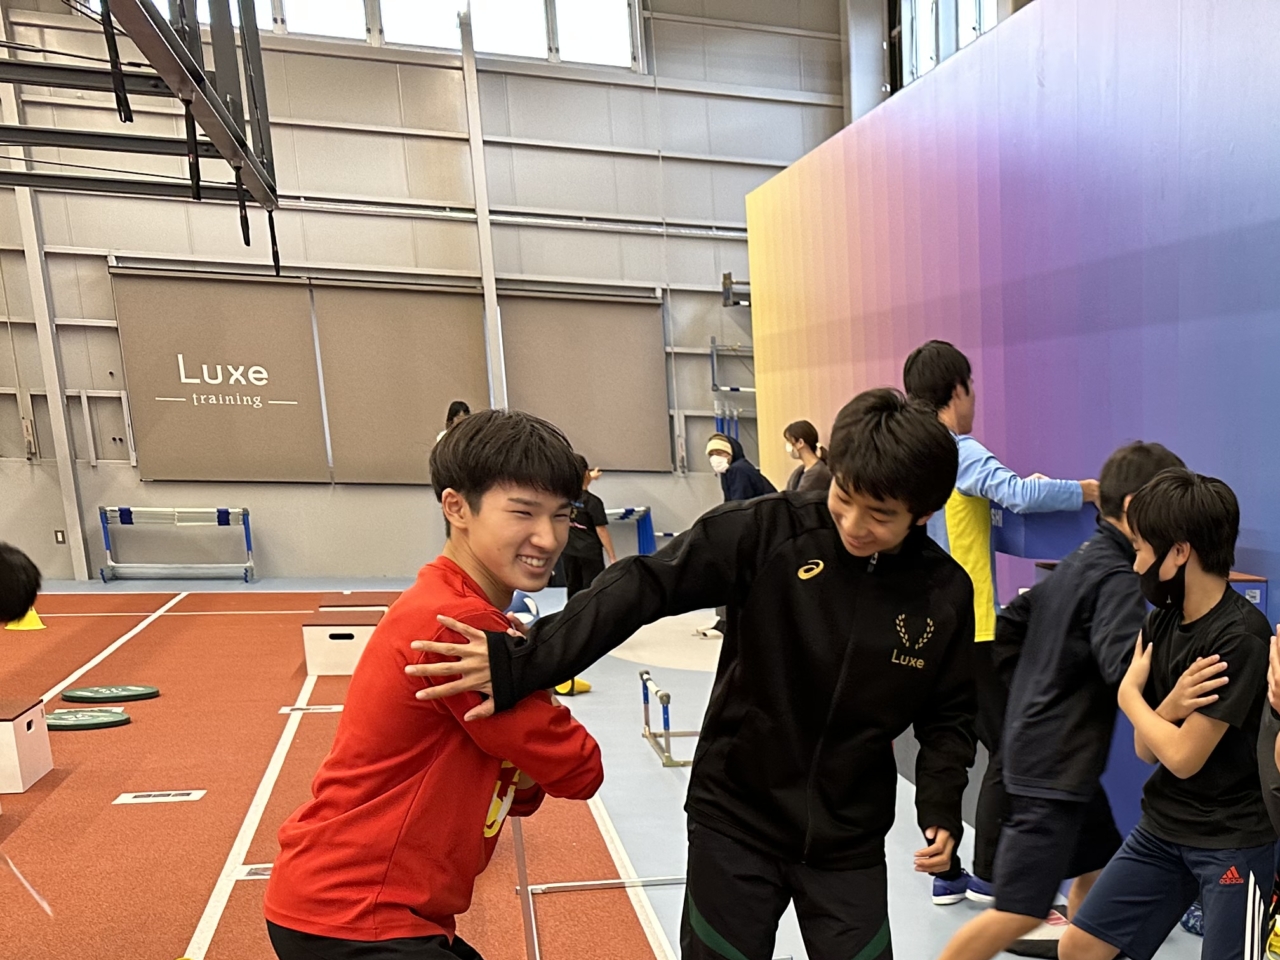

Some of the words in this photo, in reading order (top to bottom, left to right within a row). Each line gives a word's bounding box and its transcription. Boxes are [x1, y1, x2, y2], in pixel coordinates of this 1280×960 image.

[177, 353, 269, 386] Luxe
[192, 393, 263, 409] training
[891, 648, 925, 669] Luxe
